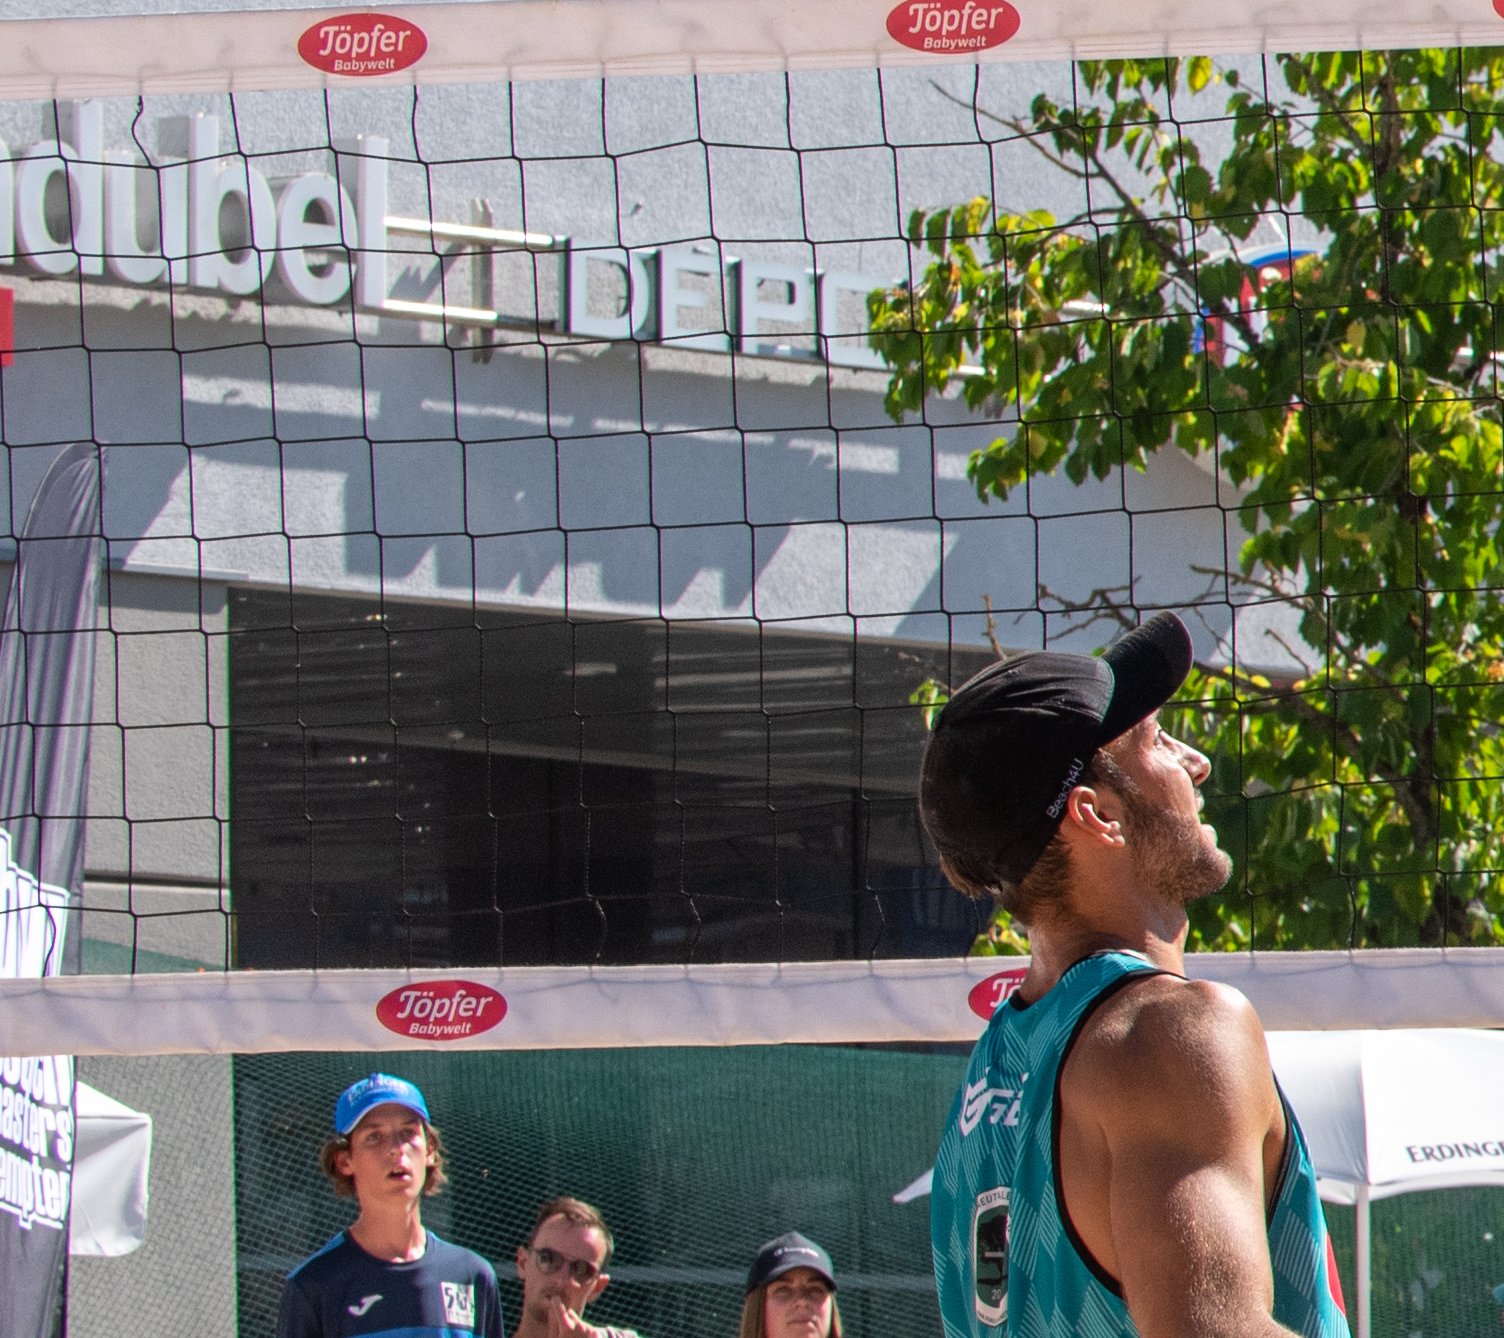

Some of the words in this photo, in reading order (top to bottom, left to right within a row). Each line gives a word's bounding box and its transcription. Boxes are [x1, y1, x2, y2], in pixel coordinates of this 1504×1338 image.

[909, 1, 1003, 35] Töpfer
[320, 23, 411, 58] Töpfer
[924, 36, 986, 49] Babywelt
[334, 58, 395, 72] Babywelt
[1045, 757, 1085, 820] Beach4U
[397, 989, 494, 1023] Töpfer
[410, 1023, 472, 1035] Babywelt
